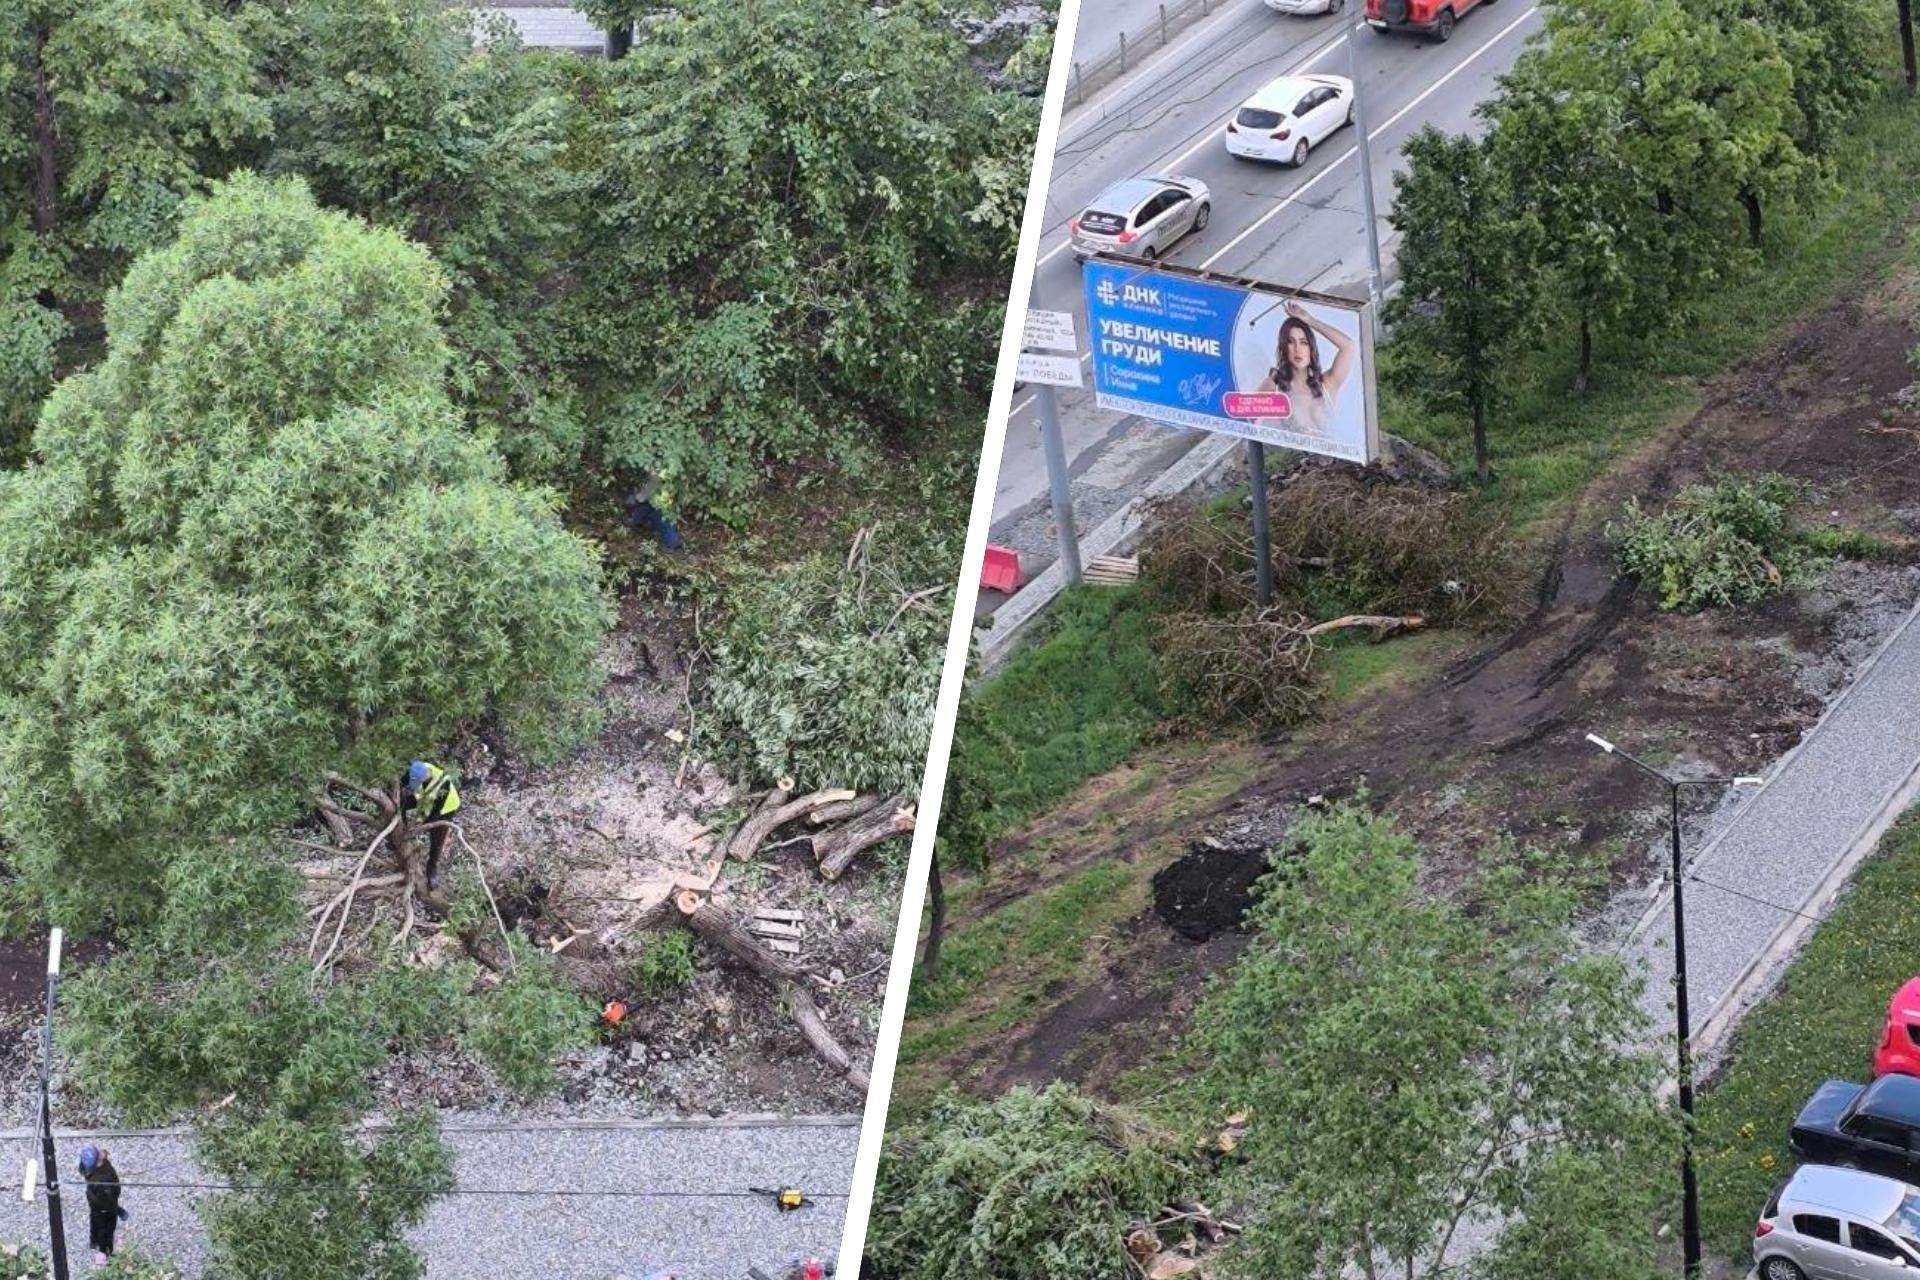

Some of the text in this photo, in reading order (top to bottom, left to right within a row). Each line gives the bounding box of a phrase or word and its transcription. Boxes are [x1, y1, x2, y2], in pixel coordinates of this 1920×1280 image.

[1123, 285, 1161, 306] ДНК
[1100, 319, 1222, 358] УВЕЛИЧЕНИЕ
[1102, 339, 1163, 367] ГРУДИ
